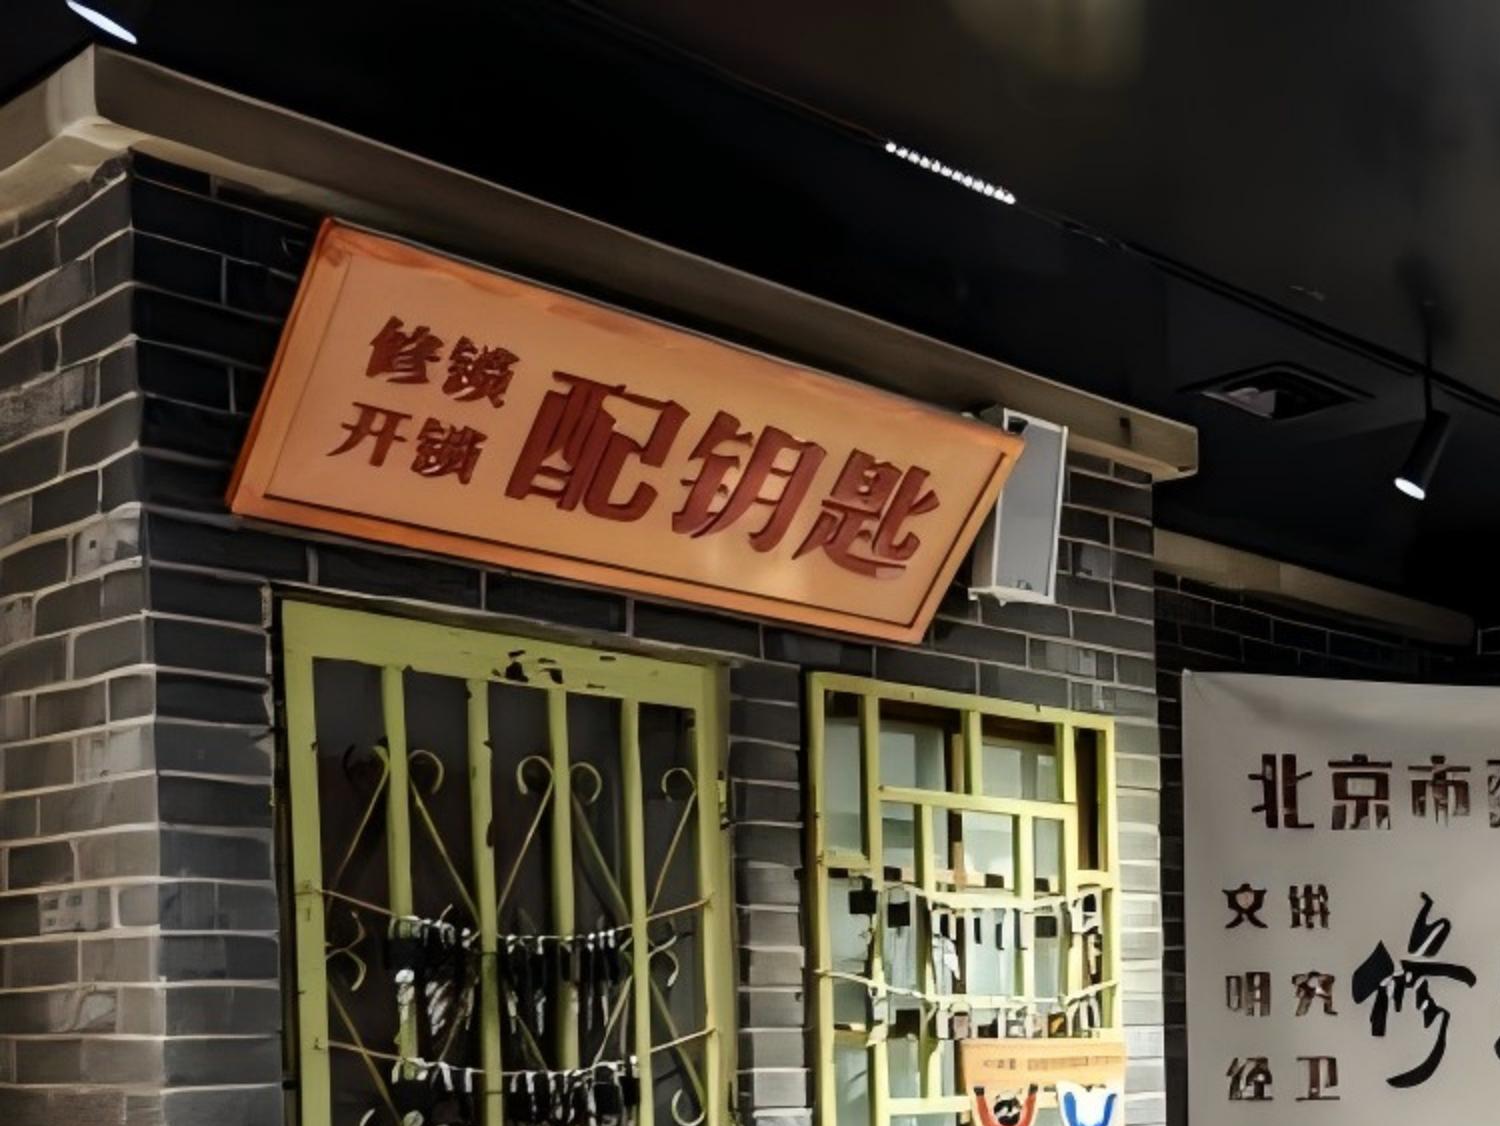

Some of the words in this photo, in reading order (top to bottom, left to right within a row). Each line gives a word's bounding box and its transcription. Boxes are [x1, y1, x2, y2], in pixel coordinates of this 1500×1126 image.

[365, 315, 520, 409] 修锁
[326, 401, 488, 484] 开锁
[504, 369, 940, 580] 配钥匙
